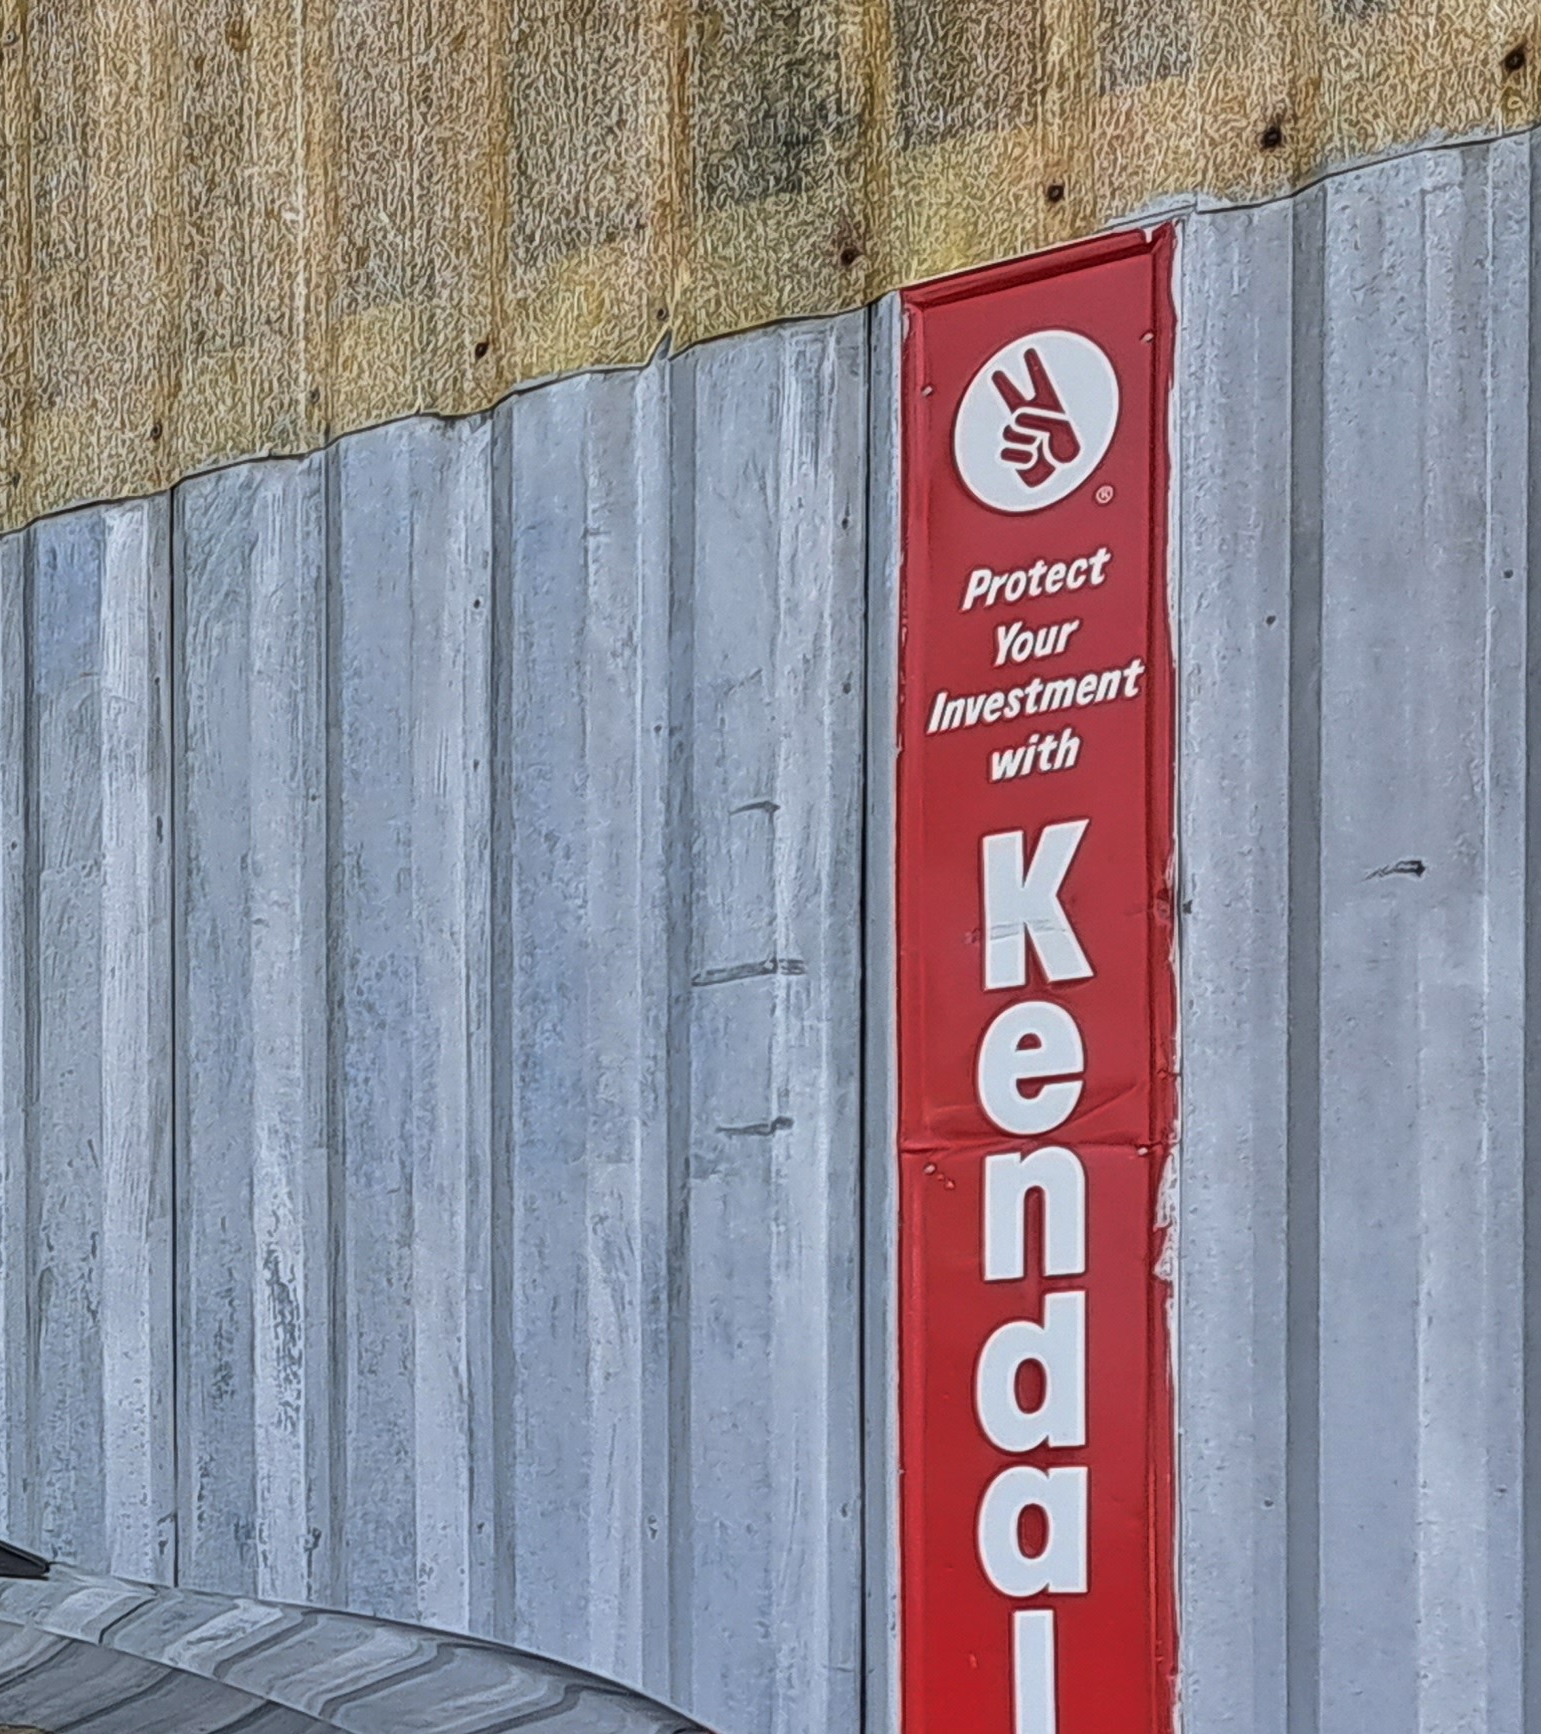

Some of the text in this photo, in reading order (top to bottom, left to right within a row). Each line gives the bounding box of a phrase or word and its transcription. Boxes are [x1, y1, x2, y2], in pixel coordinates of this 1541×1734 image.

[961, 547, 1111, 611] Protect
[995, 619, 1080, 666] Your
[927, 659, 1145, 734] Investment
[991, 727, 1081, 781] with
